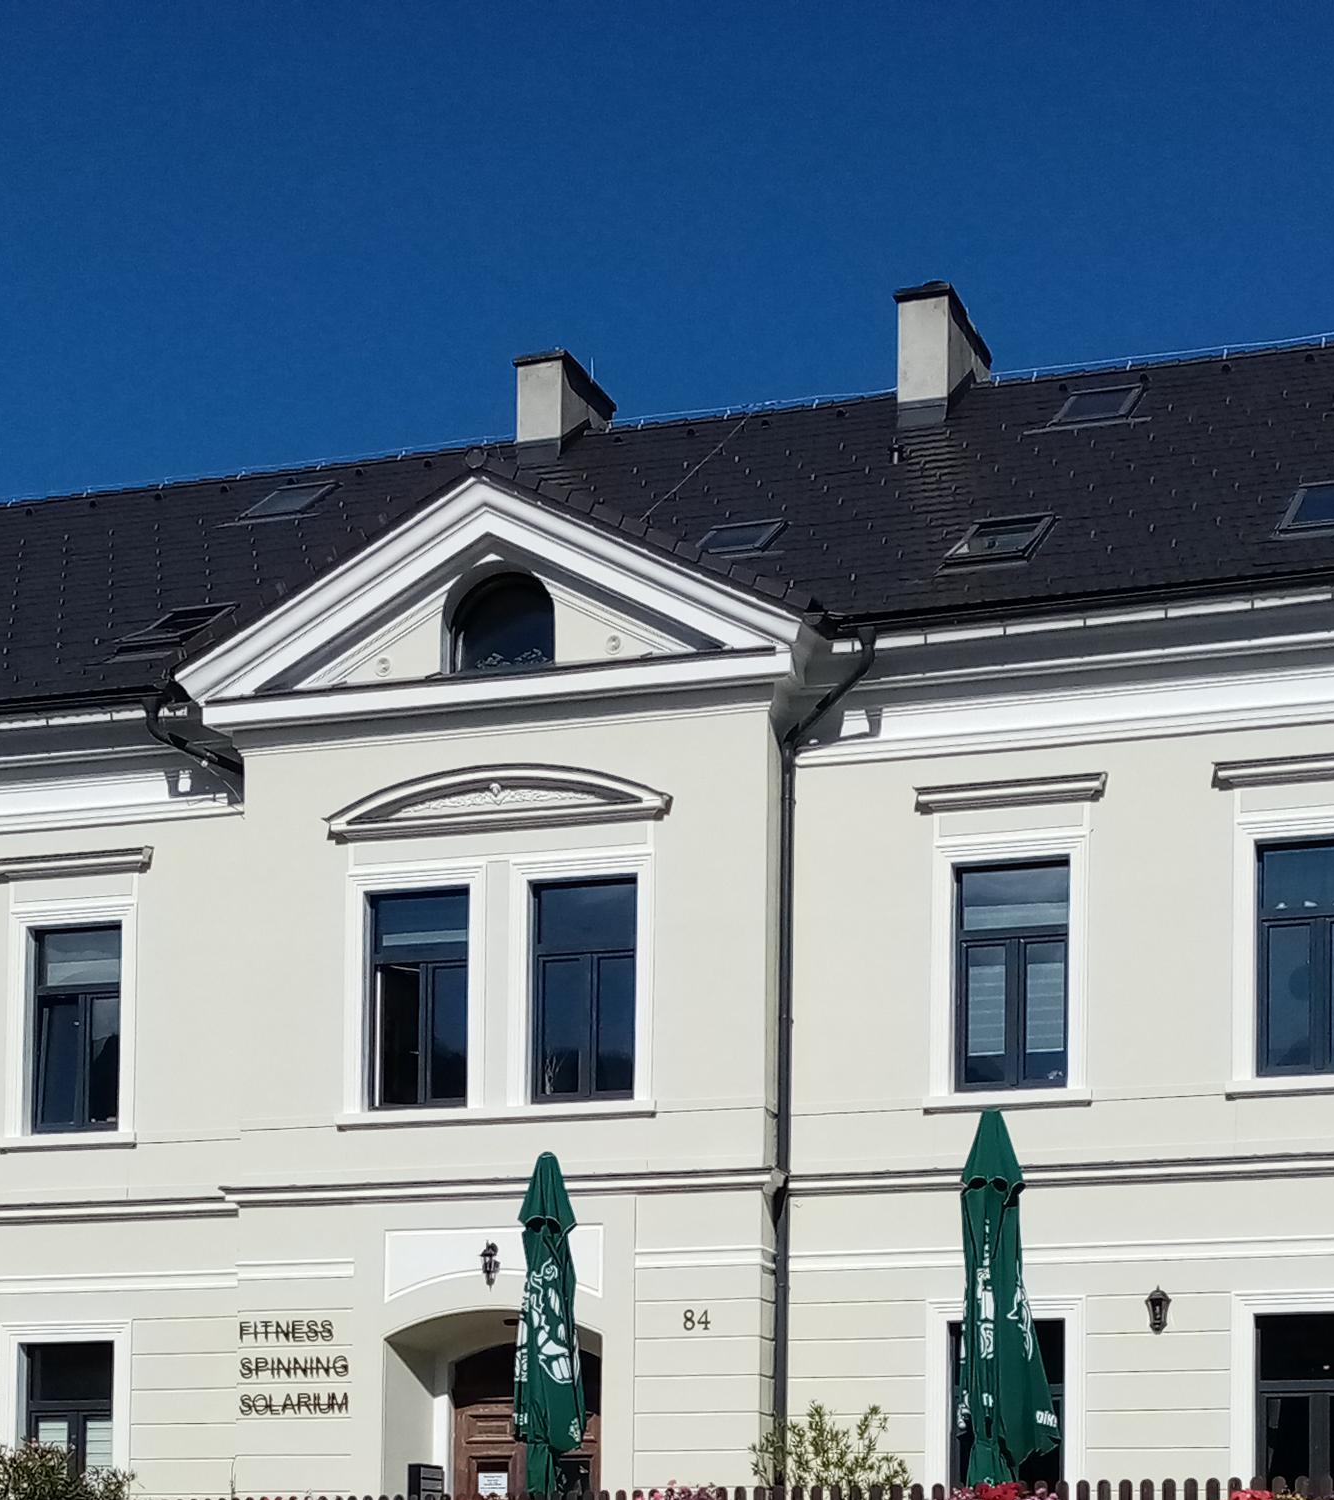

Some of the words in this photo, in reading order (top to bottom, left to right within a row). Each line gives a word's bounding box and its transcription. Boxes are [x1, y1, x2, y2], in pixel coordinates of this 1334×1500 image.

[238, 1319, 334, 1343] FITNESS
[683, 1309, 711, 1331] 84
[239, 1355, 349, 1379] SPINNING
[238, 1392, 349, 1416] SOLARIUM
